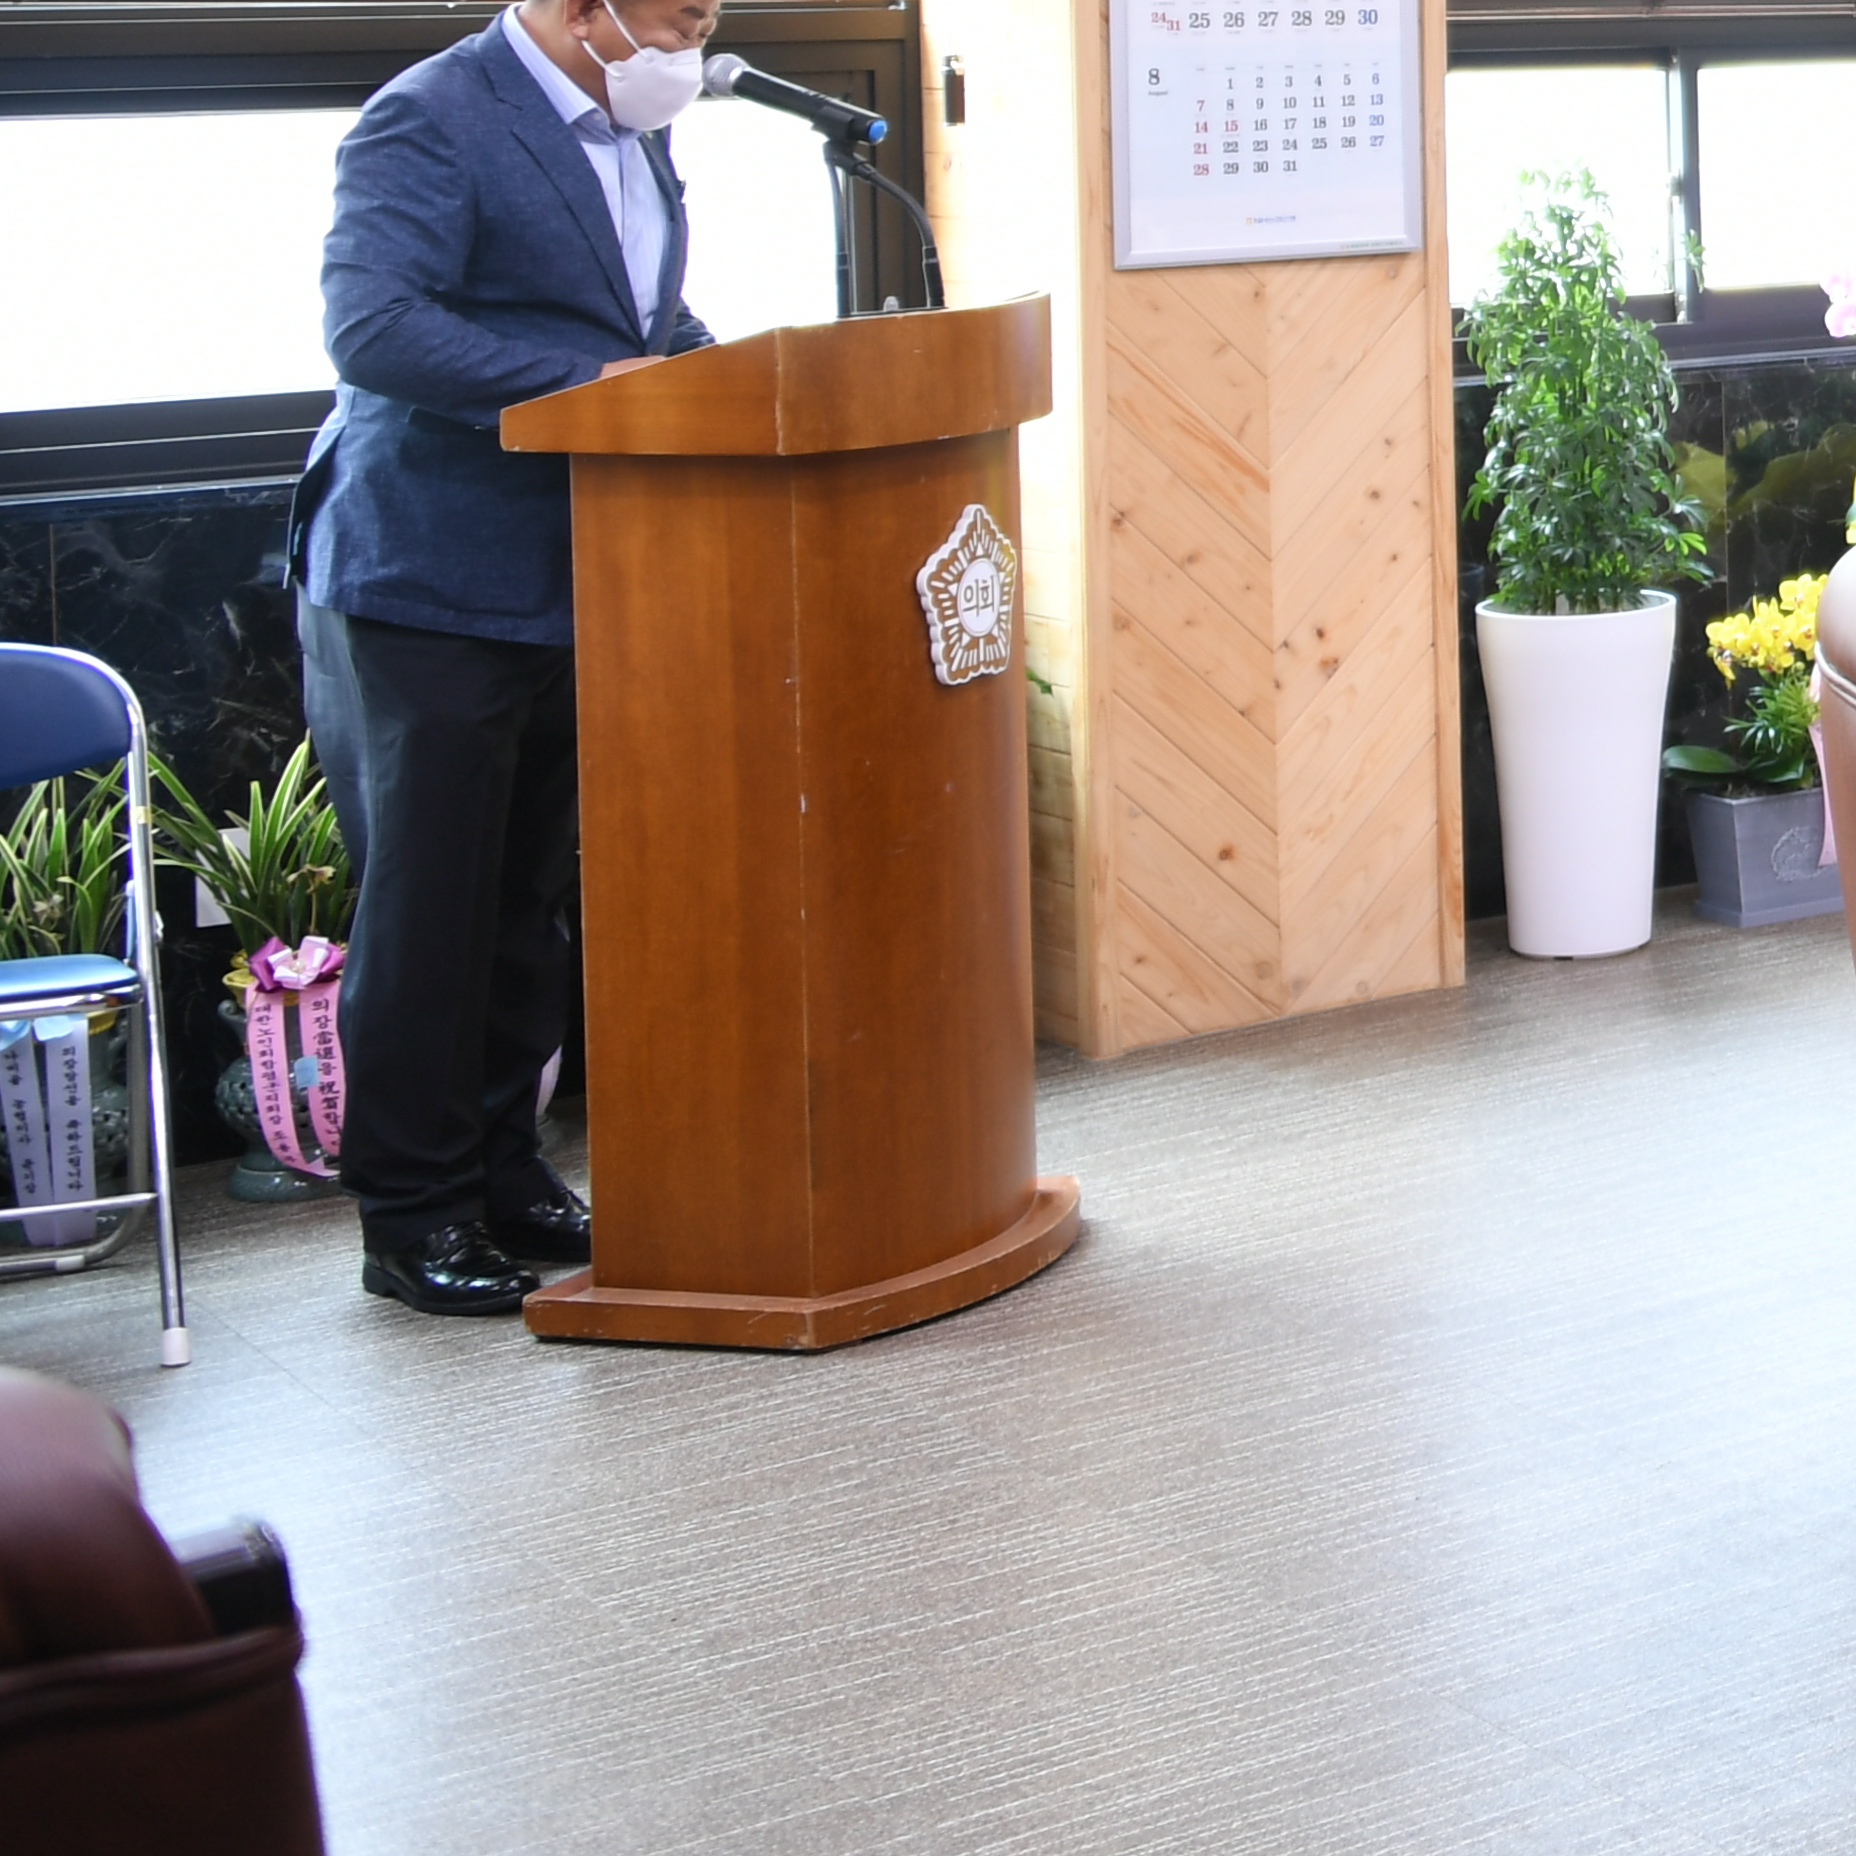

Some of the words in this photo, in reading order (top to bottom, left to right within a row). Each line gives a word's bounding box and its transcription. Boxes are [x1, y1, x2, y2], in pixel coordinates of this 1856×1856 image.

[1152, 12, 1166, 23] 24
[1166, 20, 1180, 31] 31
[1189, 13, 1210, 28] 25
[1224, 12, 1244, 27] 26
[1258, 12, 1278, 27] 27
[1292, 11, 1312, 26] 28
[1325, 10, 1345, 25] 29
[1358, 9, 1378, 25] 30
[1148, 67, 1161, 85] 8
[1227, 77, 1234, 90] 1
[1255, 76, 1264, 88] 2
[1284, 75, 1294, 87] 3
[1314, 74, 1322, 86] 4
[1343, 73, 1352, 85] 5
[1371, 72, 1380, 85] 6
[1196, 99, 1206, 111] 7
[1226, 98, 1235, 110] 8
[1255, 97, 1265, 109] 9
[1283, 97, 1297, 109] 10
[1313, 96, 1324, 107] 11
[1341, 95, 1355, 106] 12
[1370, 94, 1383, 105] 13
[1195, 122, 1208, 133] 14
[1224, 120, 1238, 132] 15
[1254, 119, 1267, 131] 16
[1283, 118, 1297, 129] 17
[1313, 117, 1326, 128] 18
[1342, 116, 1355, 127] 19
[1369, 115, 1384, 126] 20
[1194, 143, 1207, 154] 21
[1223, 141, 1239, 153] 22
[1253, 140, 1268, 152] 23
[1283, 139, 1297, 150] 24
[1312, 138, 1327, 149] 25
[1341, 136, 1356, 148] 26
[1370, 135, 1384, 147] 27
[1194, 164, 1209, 175] 28
[1224, 163, 1239, 174] 29
[1254, 161, 1268, 172] 30
[1283, 160, 1297, 171] 31
[962, 574, 995, 618] 의회
[318, 1080, 342, 1147] 祝賀합니
